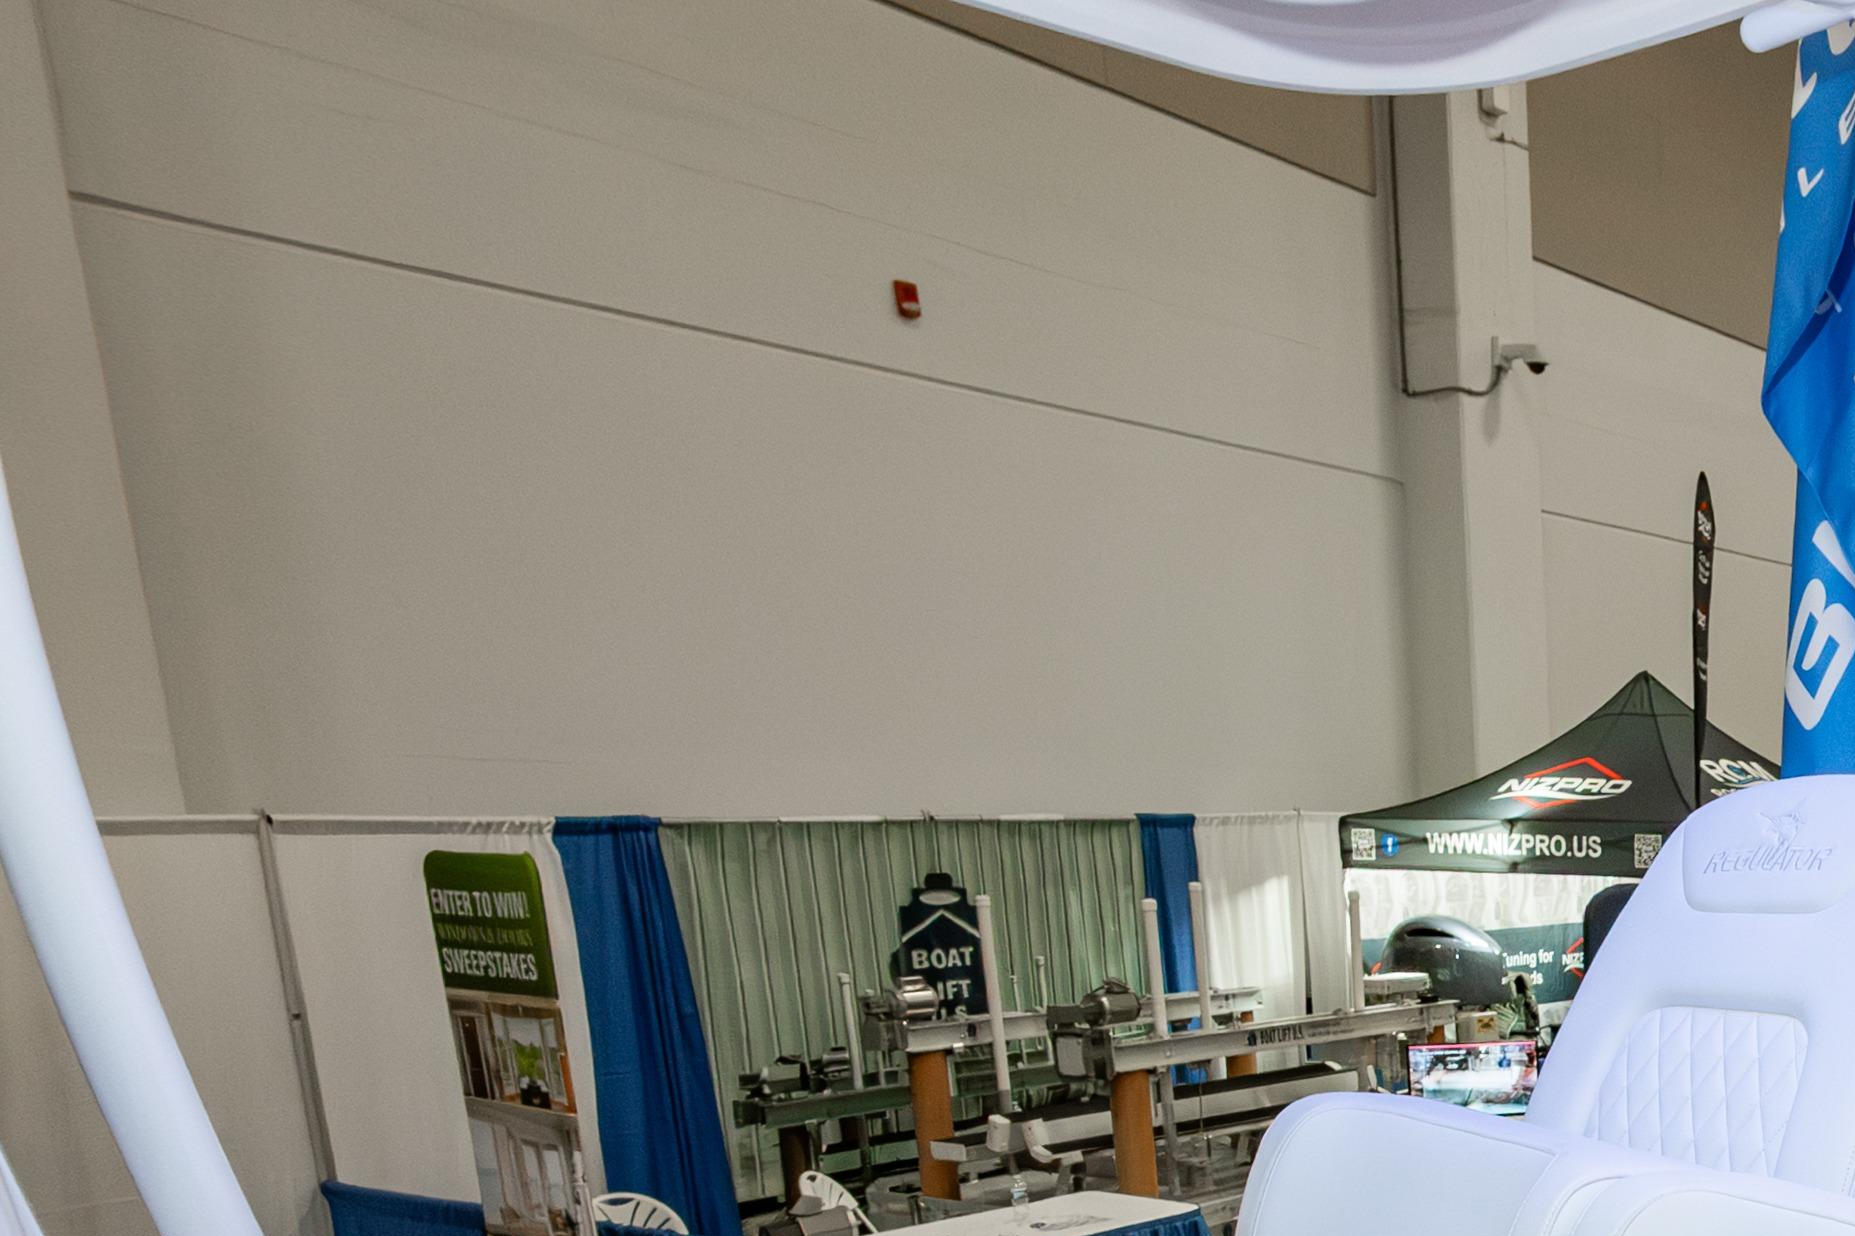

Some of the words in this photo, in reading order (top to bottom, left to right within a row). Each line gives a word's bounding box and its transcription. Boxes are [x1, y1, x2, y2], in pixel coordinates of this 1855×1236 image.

[1497, 777, 1633, 795] NIZPRO
[1426, 832, 1602, 858] WWW.NIZPRO.US
[1703, 846, 1834, 874] REGULATOR
[430, 888, 473, 916] ENTER
[472, 891, 492, 918] TO
[493, 891, 531, 919] WIN!
[442, 947, 538, 981] SWEEPSTAKES
[910, 946, 974, 970] BOAT
[1538, 948, 1555, 964] for
[936, 979, 971, 1001] IFT
